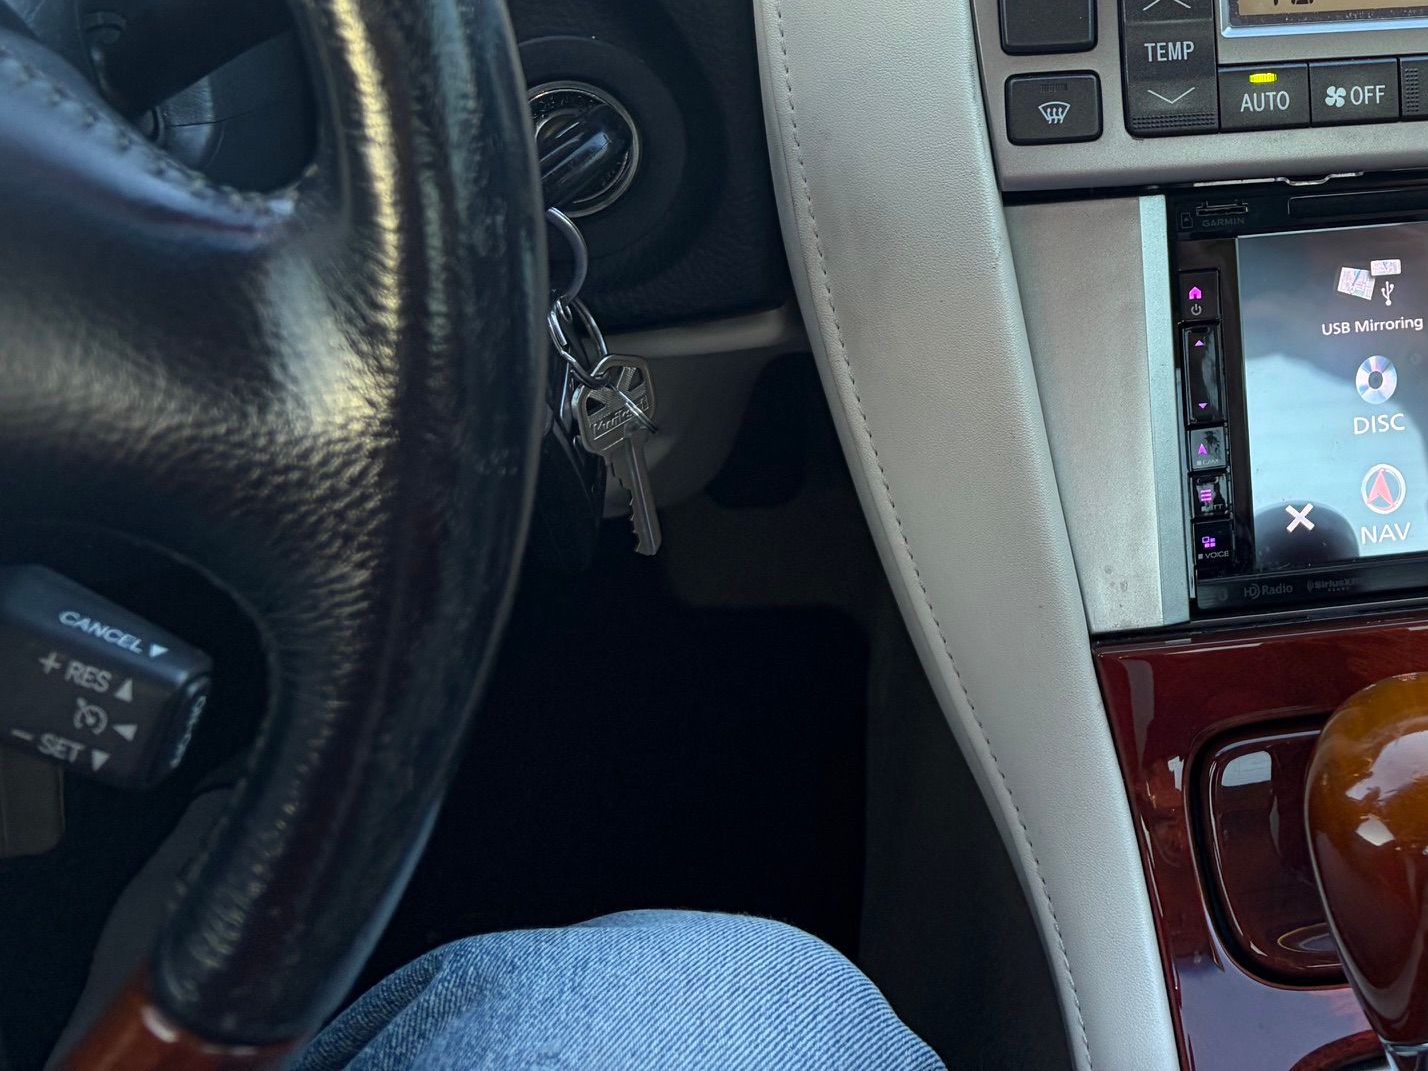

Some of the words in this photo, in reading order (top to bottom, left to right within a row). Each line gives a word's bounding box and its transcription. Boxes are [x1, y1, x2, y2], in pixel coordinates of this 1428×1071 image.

[1144, 41, 1195, 62] TEMP
[1240, 90, 1291, 113] AUTO
[1350, 85, 1386, 106] OFF
[1202, 215, 1245, 227] GARMIN
[1321, 321, 1351, 336] USB
[1355, 316, 1424, 333] Mirroring
[1353, 413, 1406, 434] DISC
[1360, 521, 1412, 545] NAV
[1205, 550, 1229, 559] VOICE
[1261, 583, 1293, 595] Radio
[58, 611, 144, 655] CANCEL
